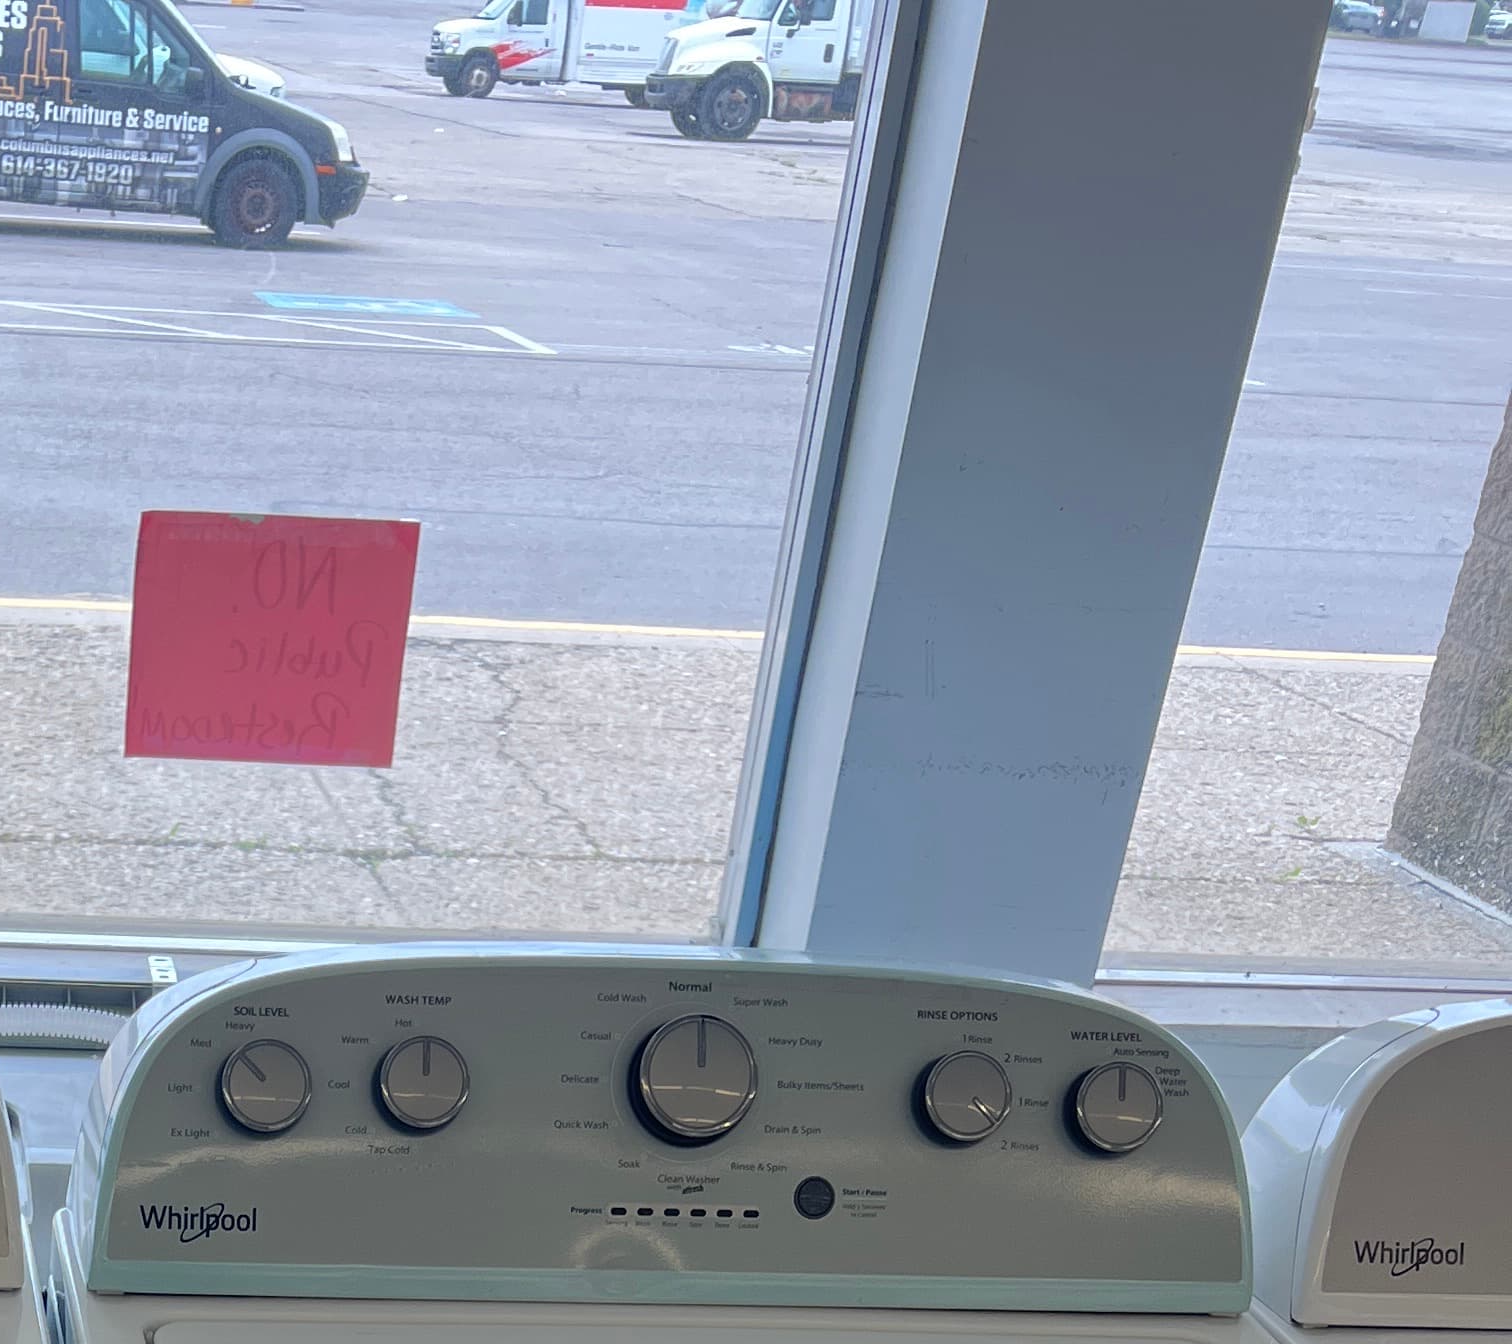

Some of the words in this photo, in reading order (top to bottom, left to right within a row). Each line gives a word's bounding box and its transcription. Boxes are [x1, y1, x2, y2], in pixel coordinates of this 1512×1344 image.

[44, 101, 121, 127] Furniture
[125, 108, 140, 128] &
[143, 108, 209, 132] Service
[669, 981, 712, 992] Normal
[386, 995, 419, 1005] WASH
[422, 996, 452, 1006] TEMP
[234, 1006, 256, 1016] SOIL
[259, 1008, 289, 1017] LEVEL
[917, 1010, 947, 1020] RINSE
[950, 1011, 998, 1021] OPTIONS
[225, 1022, 255, 1032] Heavy
[395, 1019, 412, 1028] Hot
[341, 1035, 369, 1044] Warm
[580, 1031, 611, 1040] Casual
[1071, 1031, 1108, 1041] WATER
[1110, 1032, 1143, 1042] LEVEL
[190, 1039, 212, 1048] Med
[1004, 1053, 1011, 1063] 2
[560, 1074, 599, 1083] Delicate
[168, 1083, 193, 1094] Light
[327, 1080, 350, 1089] Cool
[170, 1128, 183, 1137] Ex
[185, 1128, 210, 1139] Light
[345, 1126, 367, 1135] Cold
[368, 1145, 386, 1155] Tap
[388, 1145, 410, 1154] Cold
[618, 1159, 640, 1168] Soak
[657, 1174, 683, 1184] Clean
[685, 1175, 720, 1184] Washer
[570, 1206, 602, 1215] Progress
[140, 1203, 257, 1242] Whirlpool
[1354, 1238, 1464, 1276] Whirlpool
